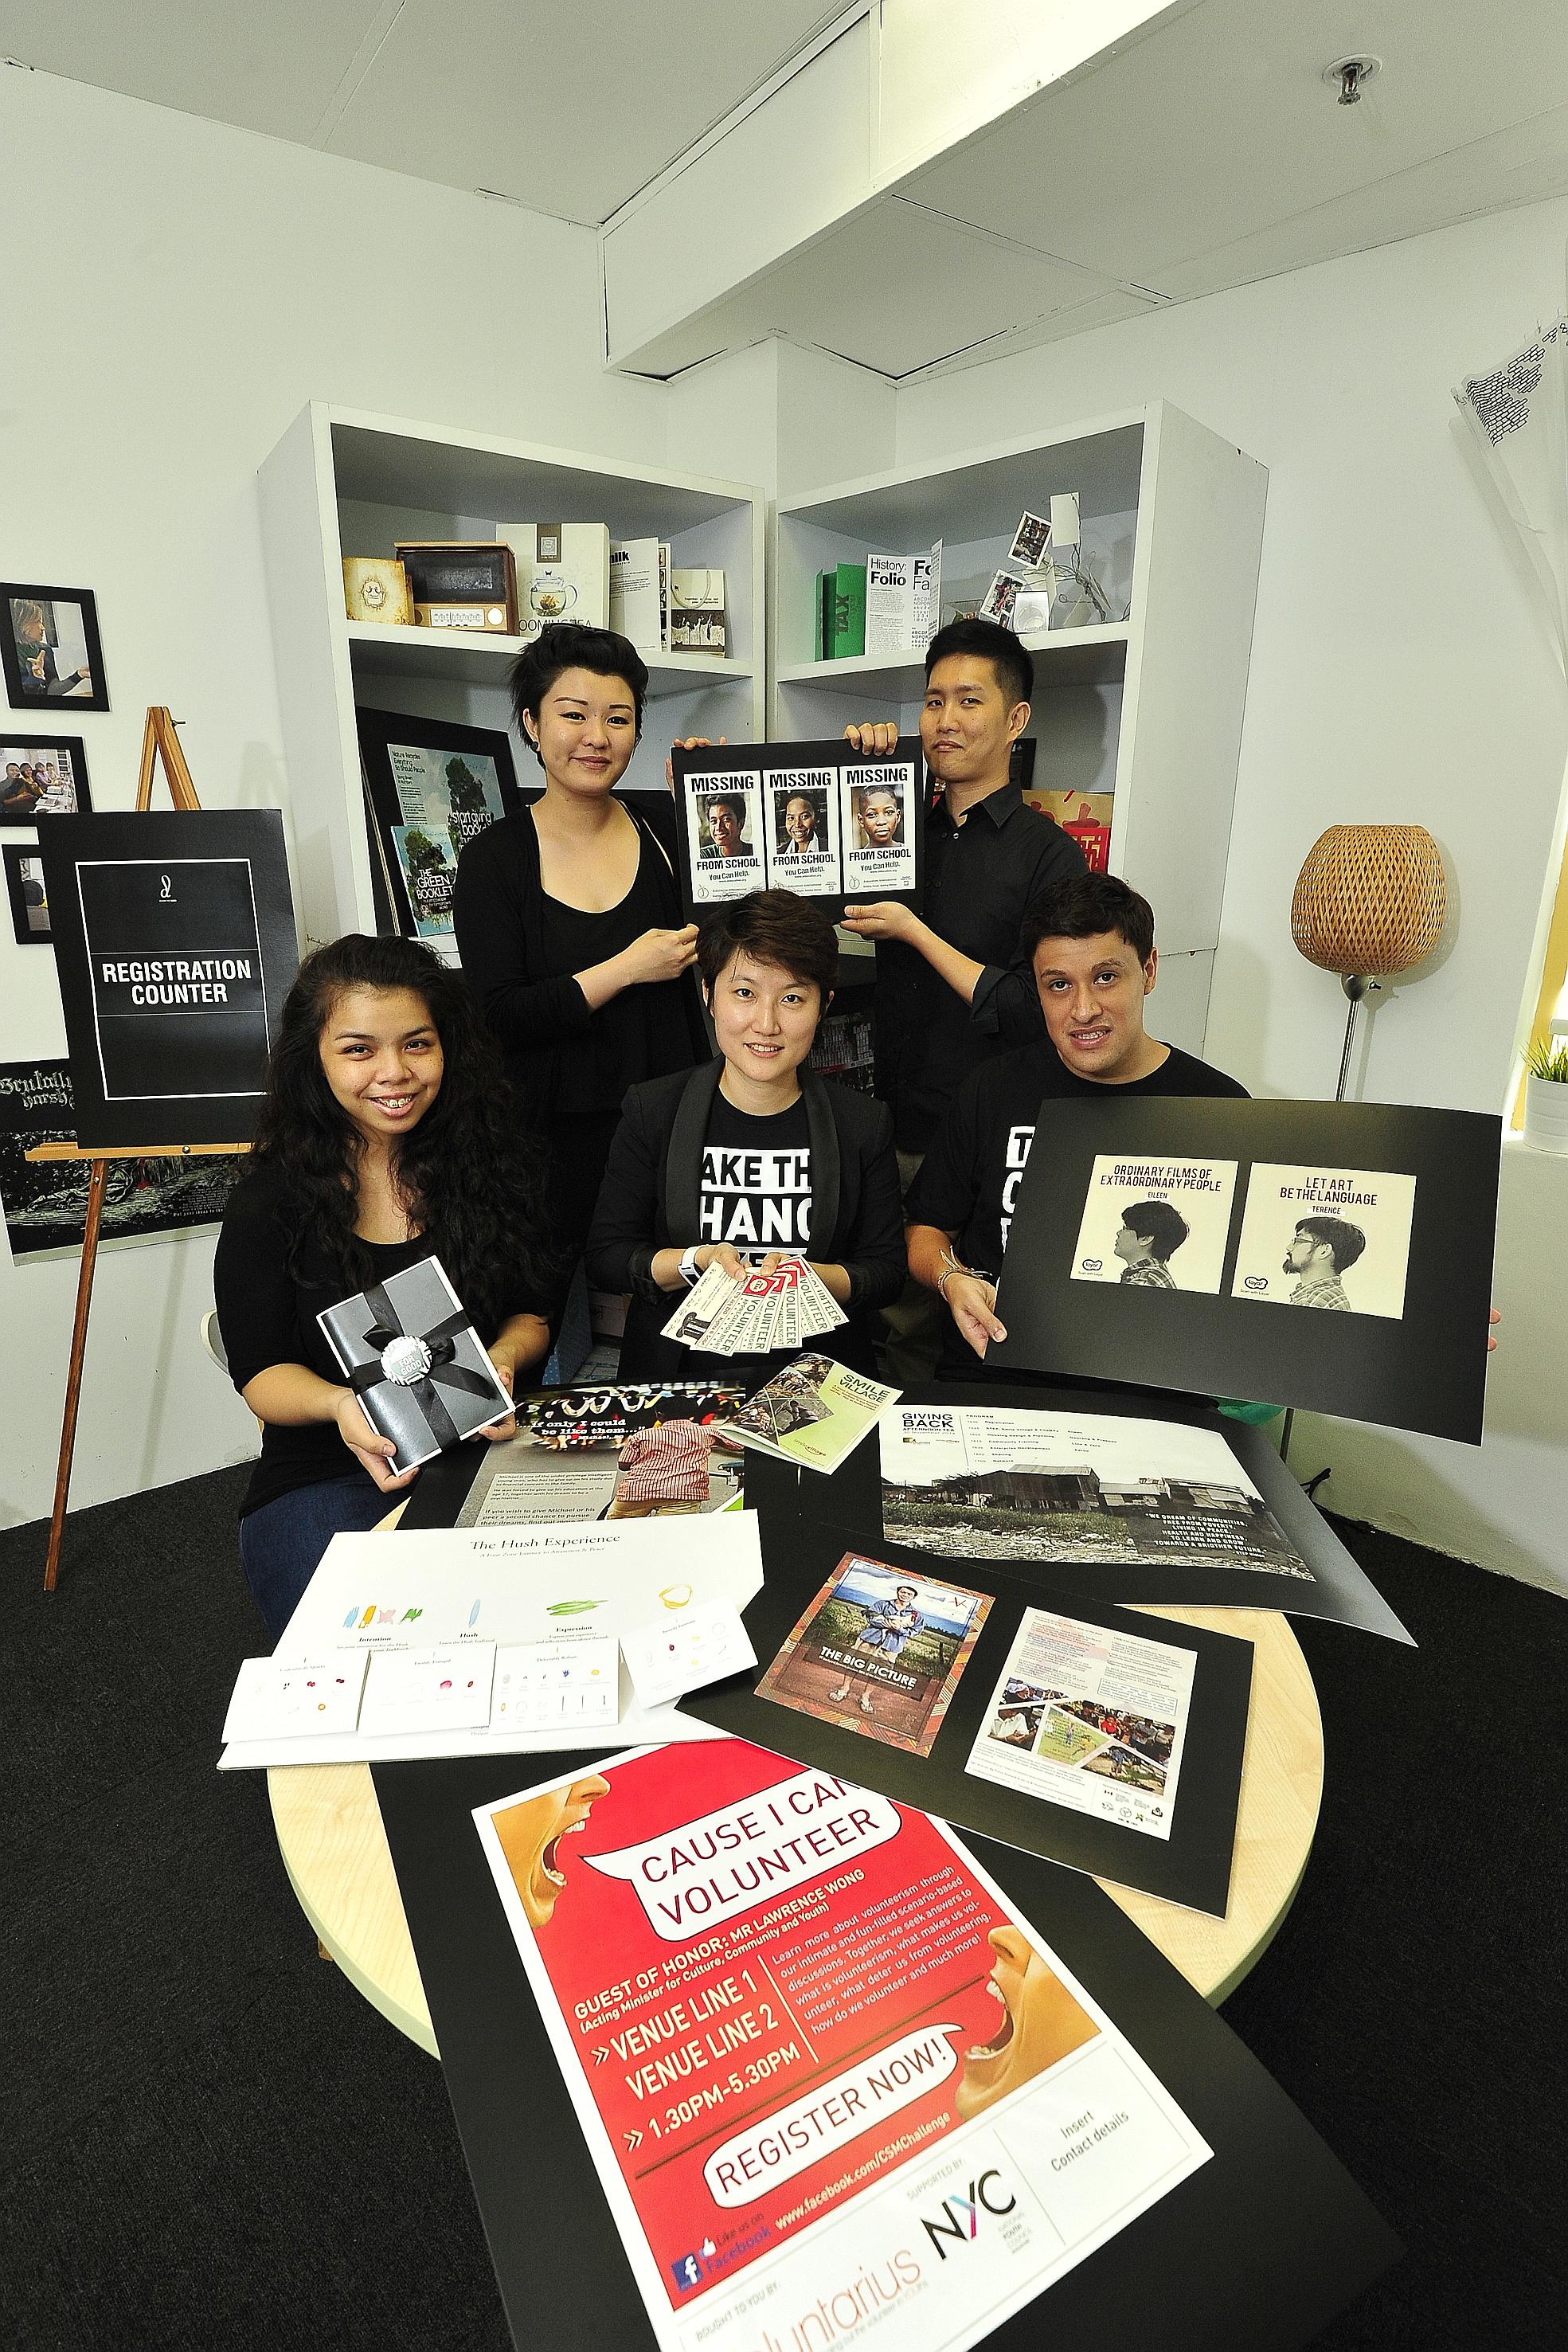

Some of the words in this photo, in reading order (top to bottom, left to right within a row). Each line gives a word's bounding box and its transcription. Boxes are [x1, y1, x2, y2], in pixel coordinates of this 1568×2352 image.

[870, 558, 907, 573] History:
[870, 571, 906, 585] Folio
[691, 775, 754, 792] MISSING
[769, 772, 831, 789] MISSING
[847, 768, 908, 785] MISSING
[419, 868, 432, 877] THE
[697, 858, 724, 871] FROM
[725, 857, 761, 868] SCHOOL
[773, 855, 800, 866] FROM
[801, 853, 835, 864] SCHOOL
[849, 851, 876, 862] FROM
[878, 849, 912, 859] SCHOOL
[416, 886, 453, 899] BOOKLET
[417, 875, 450, 888] GREEN
[102, 960, 252, 983] REGISTRATION
[131, 983, 229, 1005] COUNTER
[702, 1153, 762, 1187] AKE
[773, 1155, 811, 1188] TH
[1101, 1176, 1182, 1189] EXTRAORDINARY
[1183, 1180, 1222, 1192] PEOPLE
[1114, 1164, 1164, 1177] ORDINARY
[1167, 1167, 1198, 1179] FILMS
[1199, 1169, 1213, 1180] OF
[1306, 1177, 1327, 1188] LET
[1330, 1180, 1353, 1191] ART
[1281, 1188, 1294, 1199] BE
[1296, 1188, 1316, 1200] THE
[1318, 1191, 1378, 1205] LANGUAGE
[755, 1295, 778, 1349] VOLUNTEER
[786, 1290, 796, 1344] VOLUNTEER
[800, 1278, 827, 1330] VOLUNTEER
[720, 1299, 761, 1352] VOLUNTEER
[839, 1380, 885, 1403] VILLAGE
[843, 1374, 890, 1398] SMILE
[502, 1539, 538, 1548] Hush
[545, 1536, 620, 1548] Experience
[820, 1646, 843, 1661] THE
[843, 1654, 866, 1669] BIG
[867, 1663, 917, 1687] PICTURE
[640, 1812, 767, 1884] CAUSE
[767, 1803, 784, 1826] I
[657, 1807, 881, 1926] VOLUNTEER
[772, 1945, 802, 1965] Learn
[804, 1930, 830, 1949] more
[833, 1915, 859, 1934] about
[861, 1885, 918, 1920] volunteerism
[919, 1865, 955, 1888] through
[780, 1963, 797, 1978] our
[799, 1943, 838, 1970] intimate
[839, 1932, 856, 1947] and
[856, 1911, 898, 1938] fun-filled
[897, 1876, 964, 1916] scenario-based
[846, 1934, 890, 1963] Together,
[890, 1923, 904, 1935] we
[903, 1913, 925, 1931] seek
[925, 1894, 962, 1917] answers
[961, 1888, 972, 1899] to
[574, 1979, 632, 2020] GUEST
[635, 1967, 659, 1990] OF
[661, 1935, 730, 1973] HONOR:
[729, 1924, 753, 1944] MR
[753, 1888, 827, 1931] LAWRENCE
[824, 1868, 866, 1895] WONG
[796, 1986, 821, 2006] what
[822, 1981, 832, 1992] is
[833, 1947, 897, 1985] volunteerism,
[896, 1932, 921, 1951] what
[921, 1917, 951, 1938] makes
[951, 1910, 963, 1922] us
[964, 1900, 980, 1915] vol-
[841, 1980, 866, 1999] what
[867, 1966, 892, 1986] deter
[895, 1959, 909, 1970] us
[909, 1943, 933, 1962] from
[933, 1912, 992, 1947] volunteering,
[580, 2010, 620, 2034] (Acting
[620, 1986, 664, 2012] Minister
[666, 1976, 682, 1992] for
[682, 1955, 725, 1982] Culture,
[725, 1928, 781, 1961] Community
[780, 1916, 800, 1932] and
[798, 1900, 830, 1921] Youth)
[811, 2017, 834, 2036] how
[835, 2010, 848, 2022] do
[848, 2001, 864, 2013] we
[863, 1976, 909, 2004] volunteer
[909, 1964, 928, 1981] and
[928, 1949, 956, 1970] much
[955, 1932, 982, 1954] more!
[610, 2002, 691, 2062] VENUE
[688, 1976, 744, 2022] LINE
[741, 1969, 757, 1993] 1
[625, 2040, 709, 2101] VENUE
[705, 2010, 763, 2060] LINE
[759, 2002, 779, 2031] 2
[647, 2040, 801, 2139] 1.30PM-5.30PM
[715, 2086, 867, 2194] REGISTER
[866, 2037, 948, 2100] NOW!
[1059, 2110, 1096, 2139] Insert
[1050, 2133, 1094, 2172] Contact
[1093, 2110, 1129, 2145] details
[775, 2111, 952, 2231] www.facebook.com/CSMChallenge
[919, 2169, 1017, 2260] NYC
